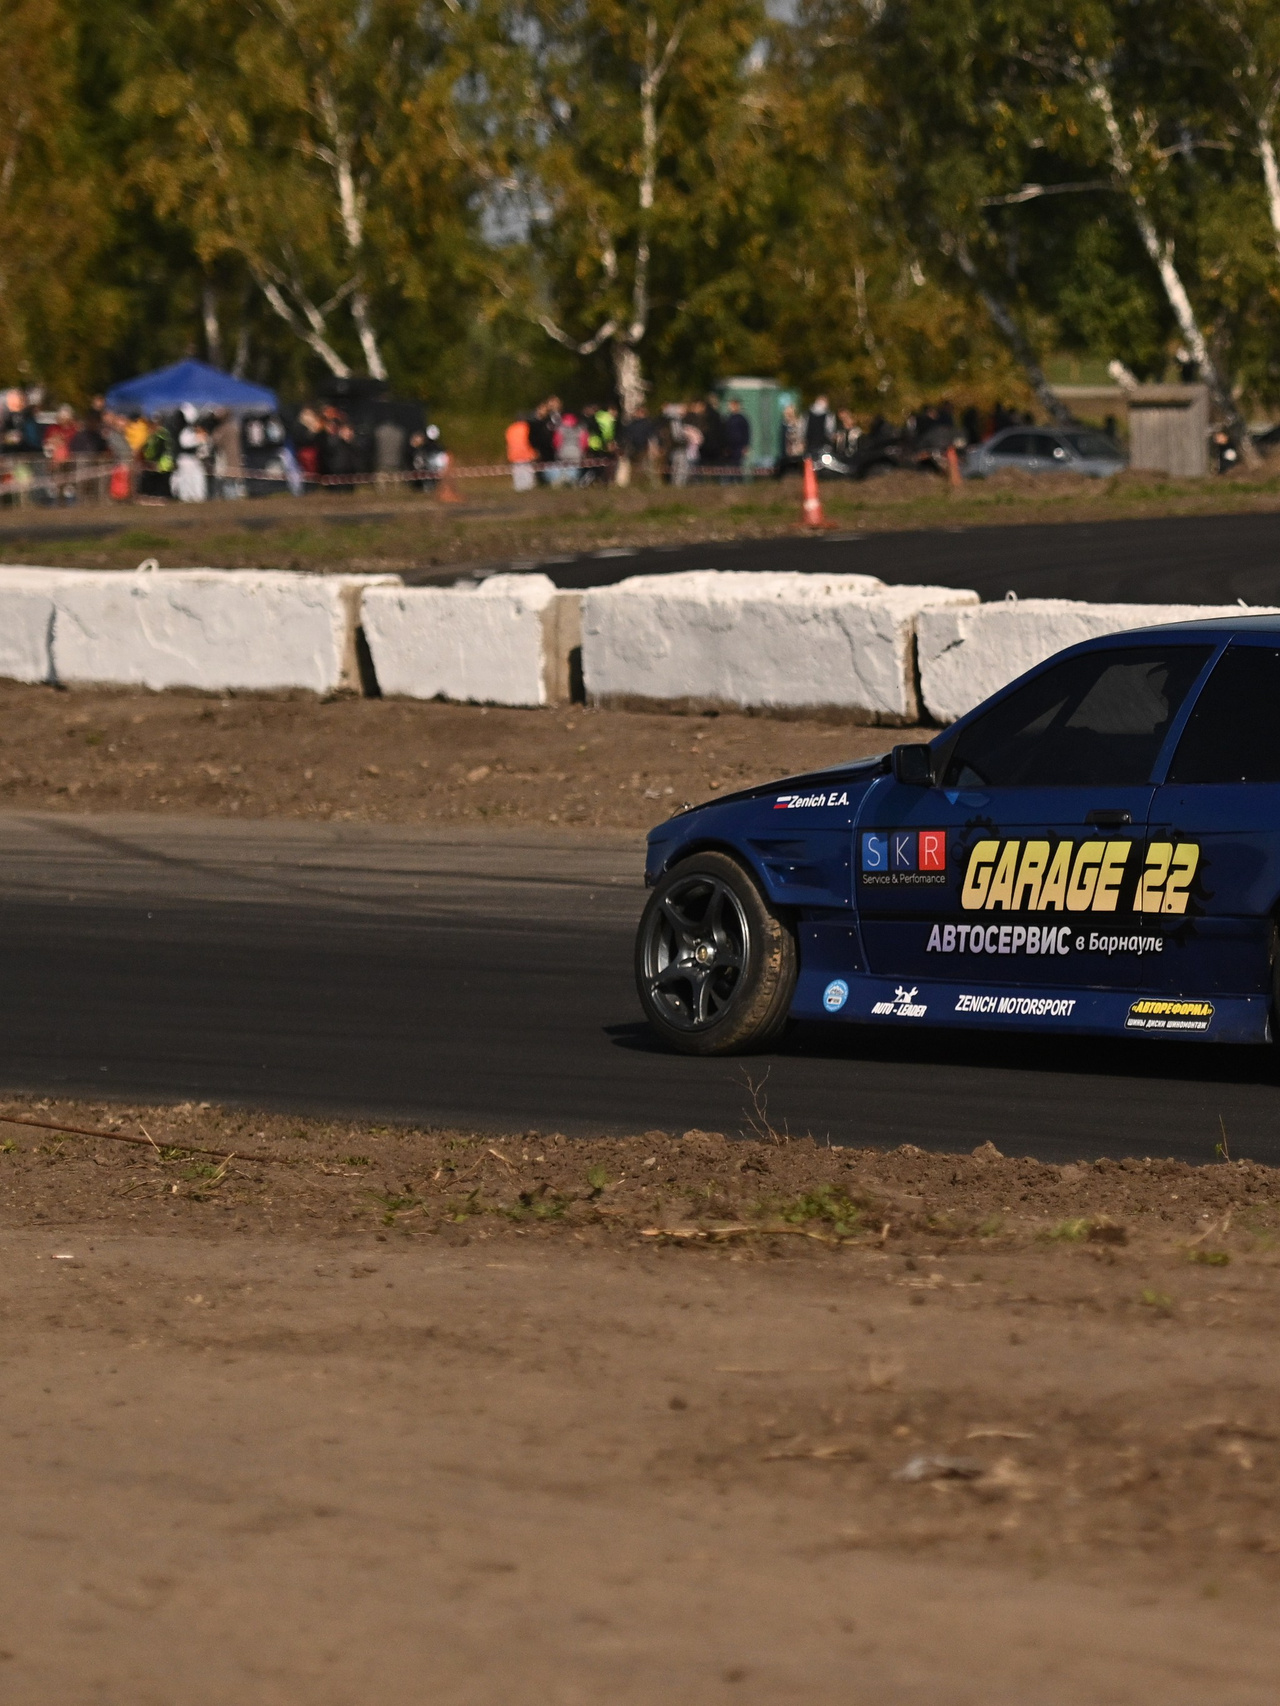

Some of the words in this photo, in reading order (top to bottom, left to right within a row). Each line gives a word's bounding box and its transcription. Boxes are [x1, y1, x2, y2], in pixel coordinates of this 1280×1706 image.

[787, 793, 826, 809] Zenich
[827, 792, 850, 806] E.A.
[862, 873, 891, 884] Service
[891, 874, 899, 884] &
[961, 841, 1132, 912] GARAGE
[1132, 842, 1200, 914] 22
[926, 924, 1072, 955] АВТОСЕРВИС
[1088, 932, 1163, 955] Барнауле
[954, 994, 998, 1013] ZENICH
[997, 996, 1077, 1017] MOTORSPORT
